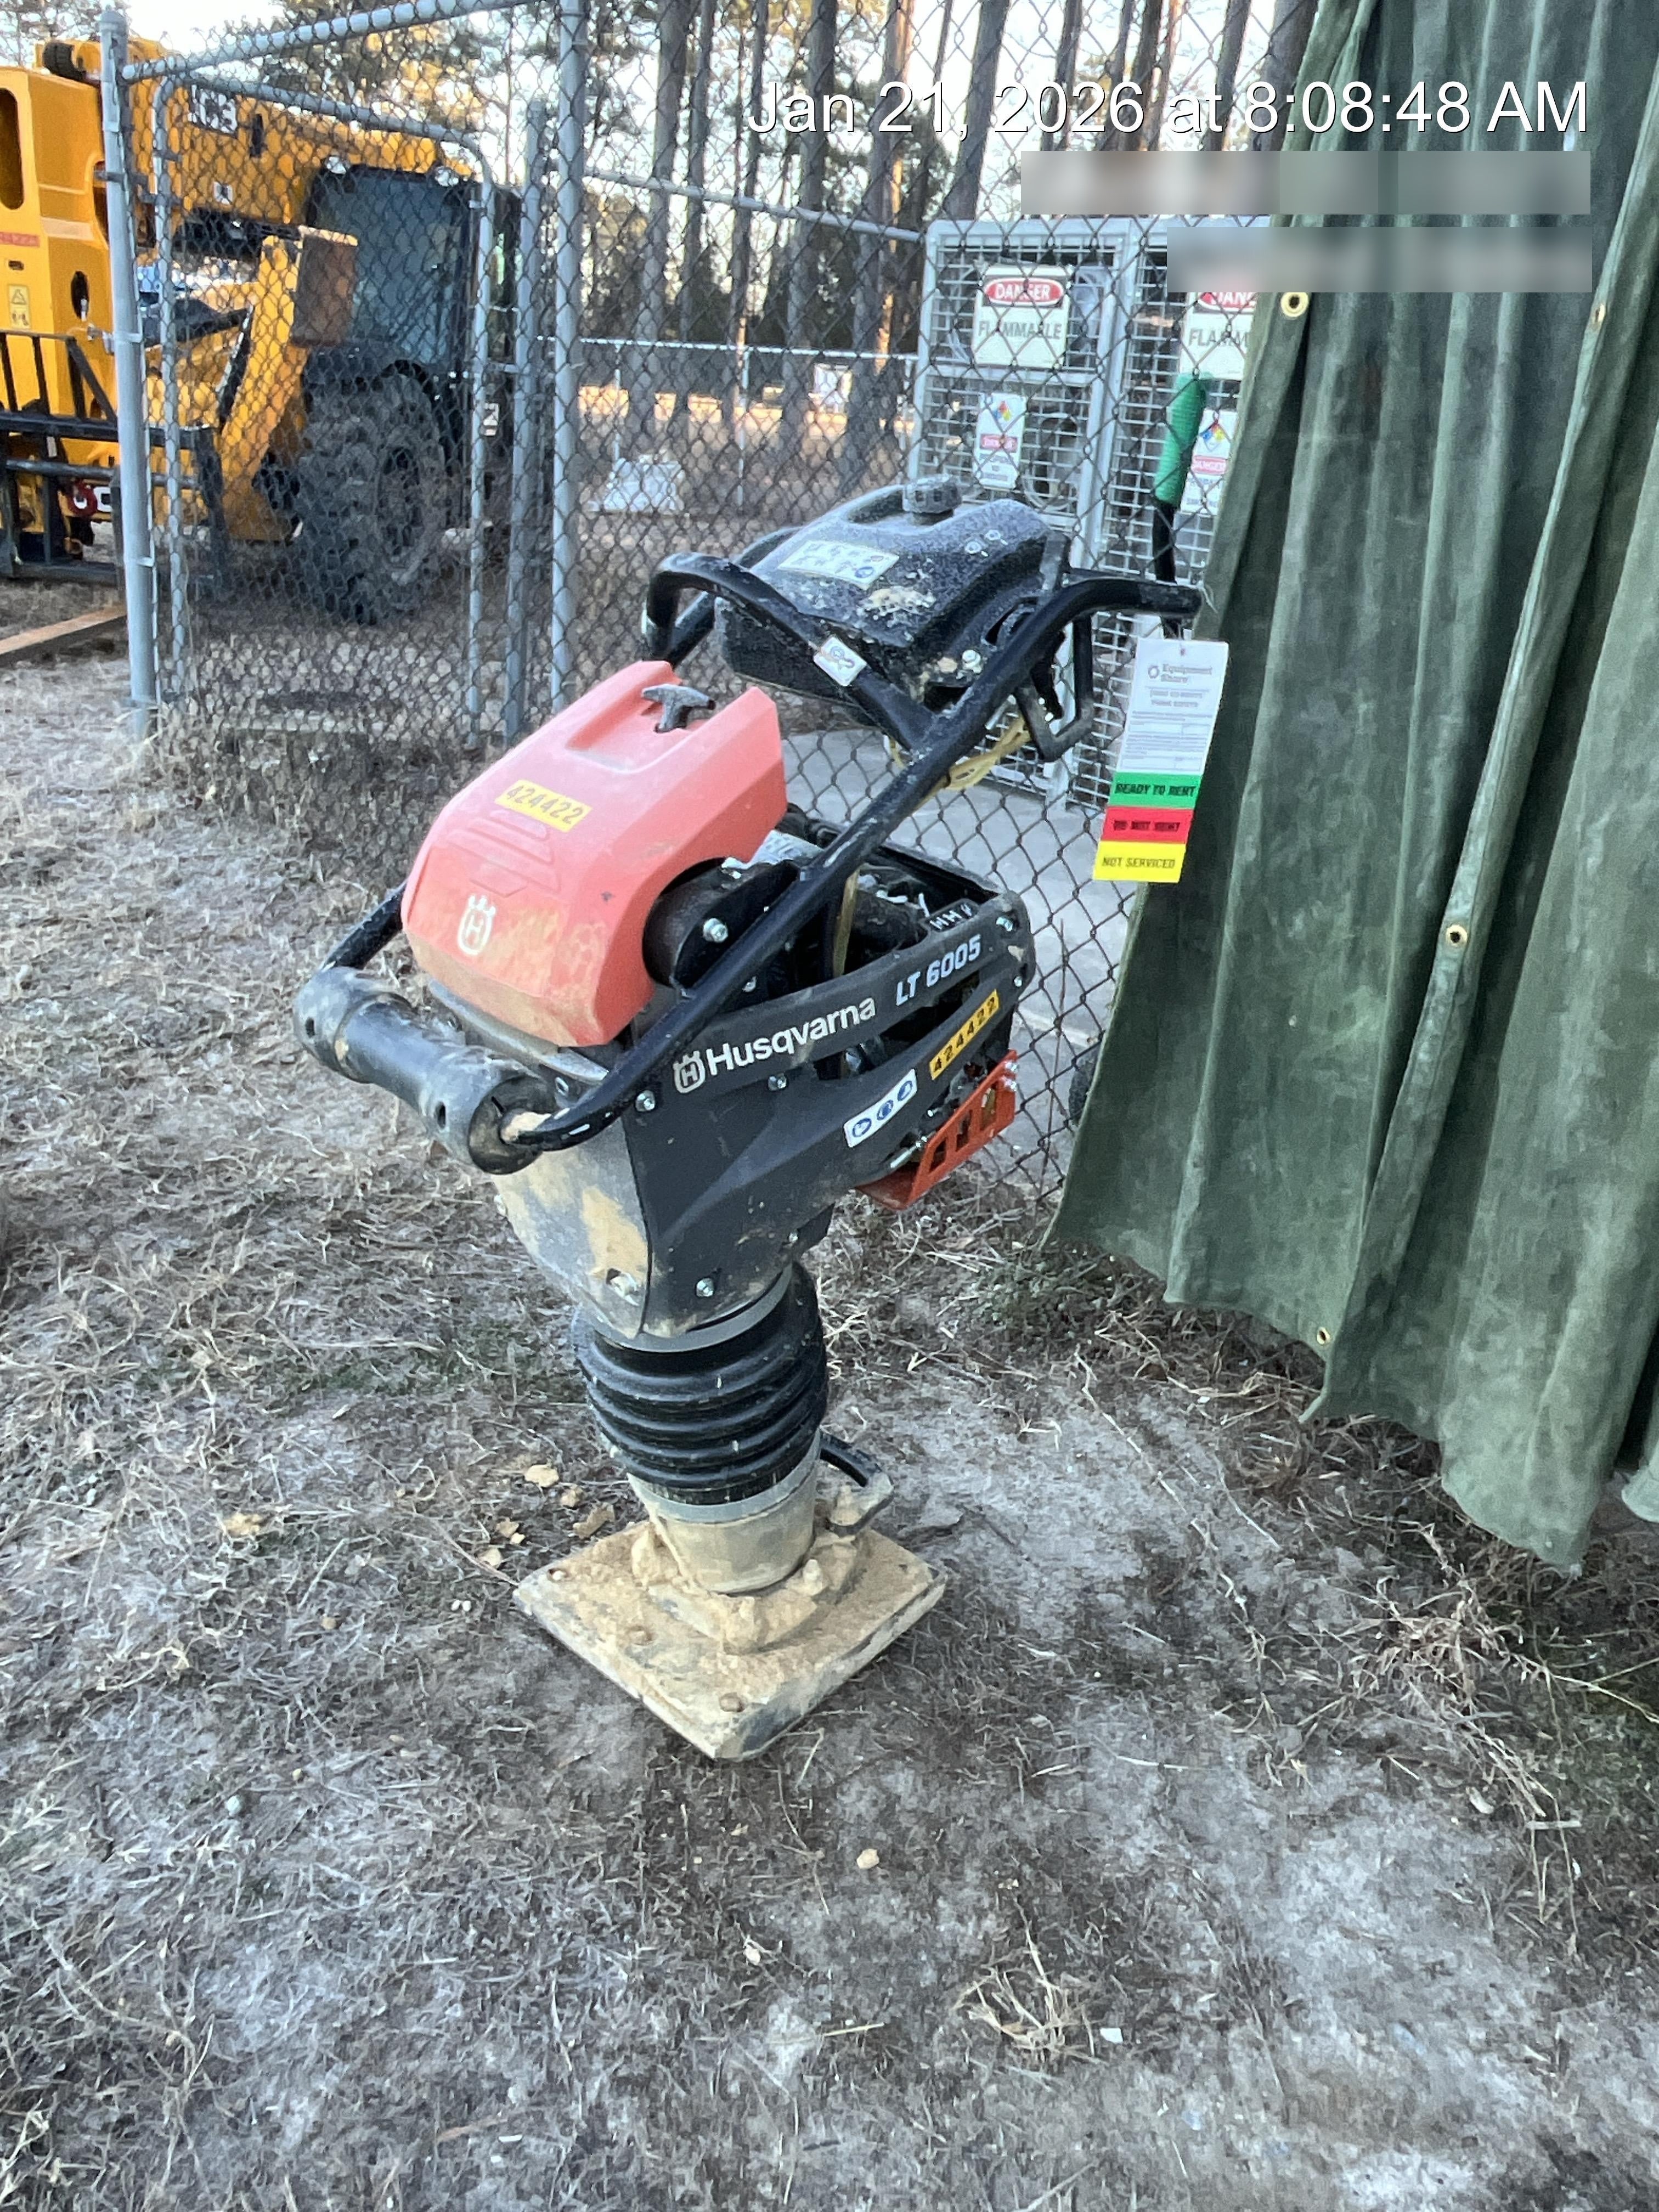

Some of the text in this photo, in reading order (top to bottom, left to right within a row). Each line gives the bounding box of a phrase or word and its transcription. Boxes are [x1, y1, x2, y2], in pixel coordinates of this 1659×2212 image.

[506, 785, 584, 825] 424422
[1114, 783, 1151, 794] READY
[1153, 785, 1166, 795] TO
[1102, 856, 1176, 868] NOT SERVICED
[896, 934, 981, 1006] LT 6005
[706, 997, 876, 1076] Husqvarna
[934, 996, 996, 1073] 424422
